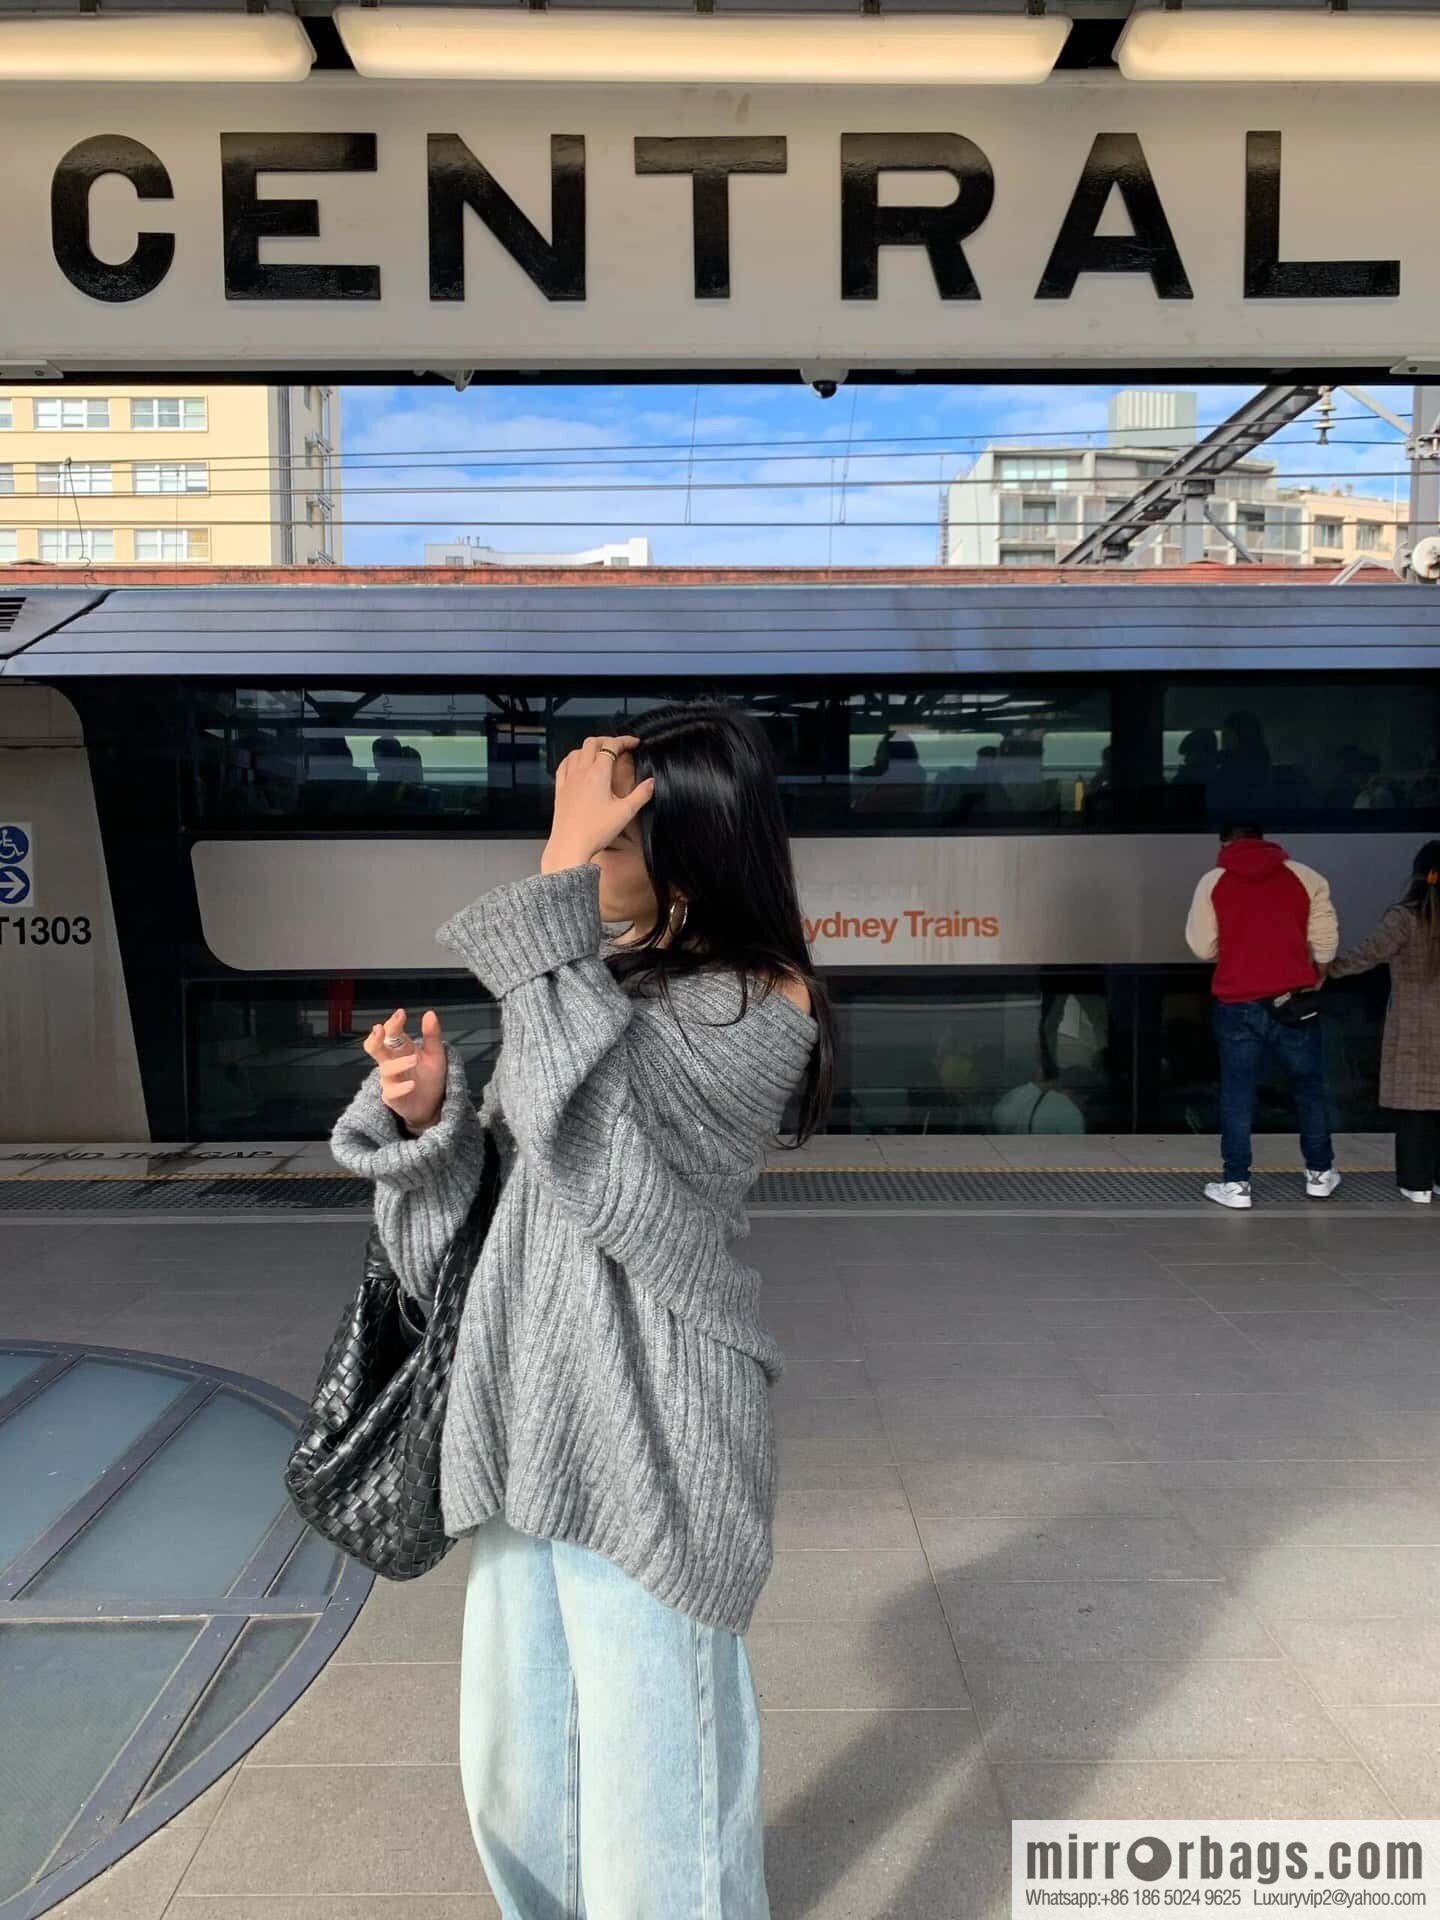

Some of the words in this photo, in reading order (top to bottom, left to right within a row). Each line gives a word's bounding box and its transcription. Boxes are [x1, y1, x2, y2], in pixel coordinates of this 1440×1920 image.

[51, 131, 1400, 303] CENTRAL
[801, 911, 898, 944] ydney
[903, 910, 999, 938] Trains
[192, 1150, 273, 1160] GAP
